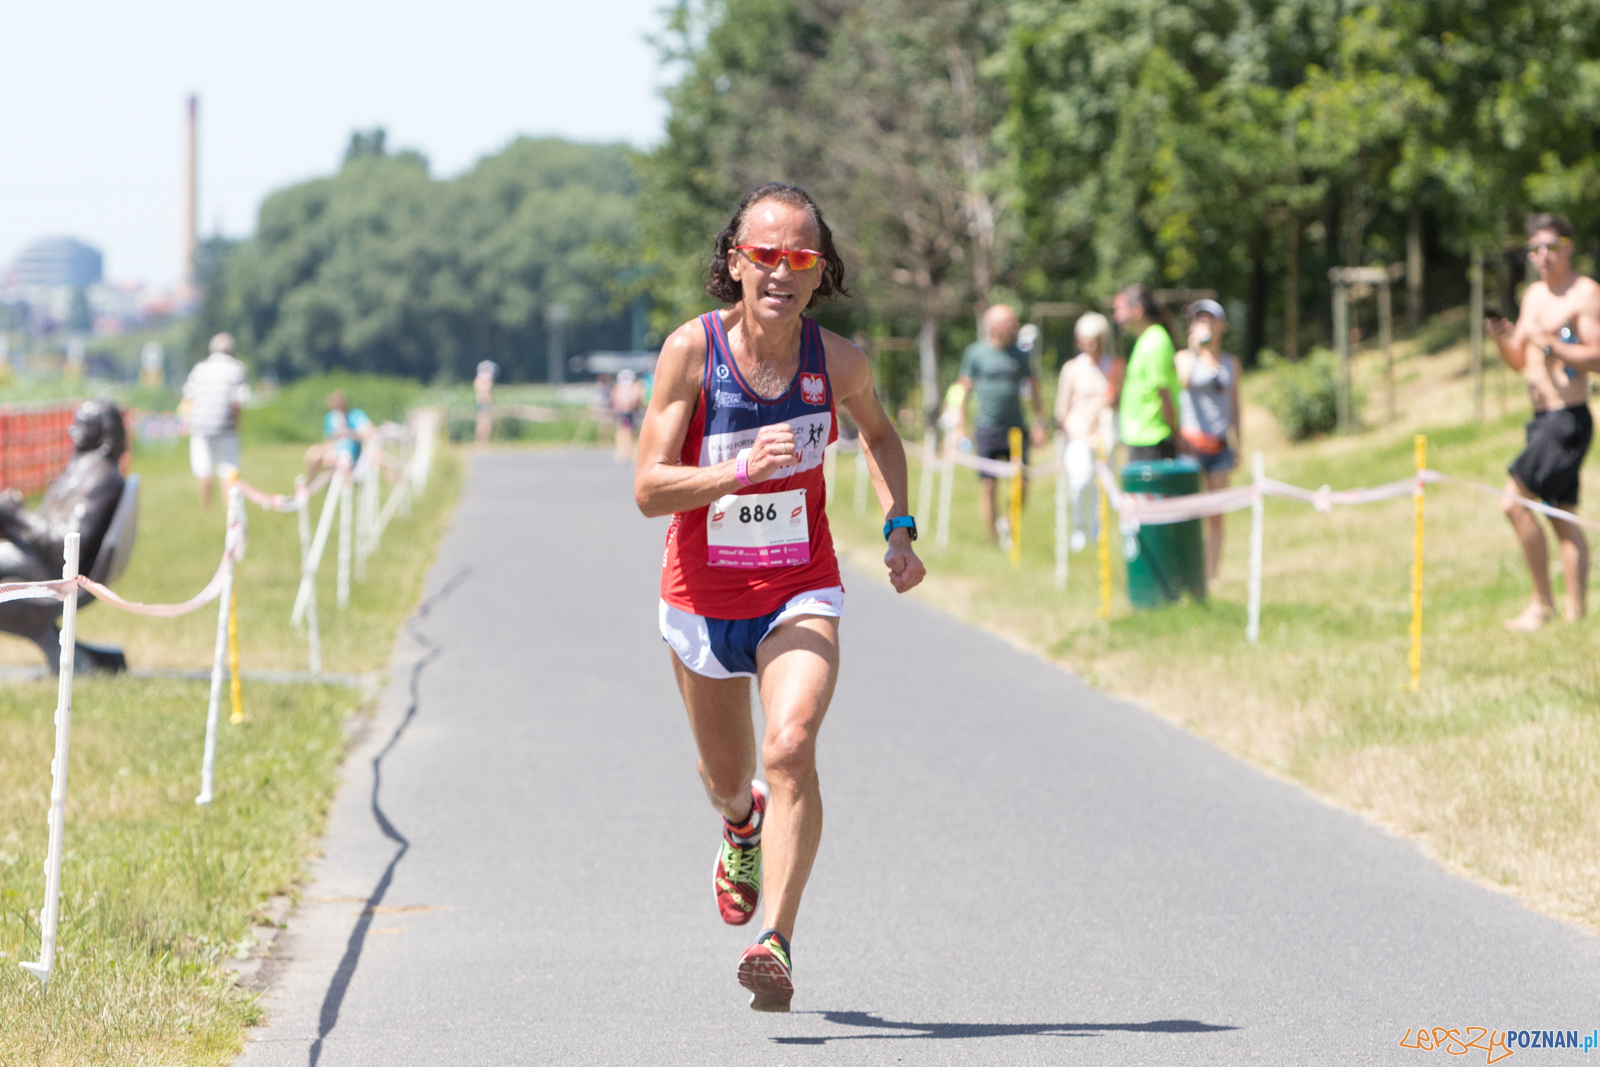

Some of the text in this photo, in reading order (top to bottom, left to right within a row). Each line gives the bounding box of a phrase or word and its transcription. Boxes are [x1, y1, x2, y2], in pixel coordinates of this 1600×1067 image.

[734, 438, 756, 449] PORTA
[739, 503, 777, 524] 886
[716, 877, 753, 913] BROOKS
